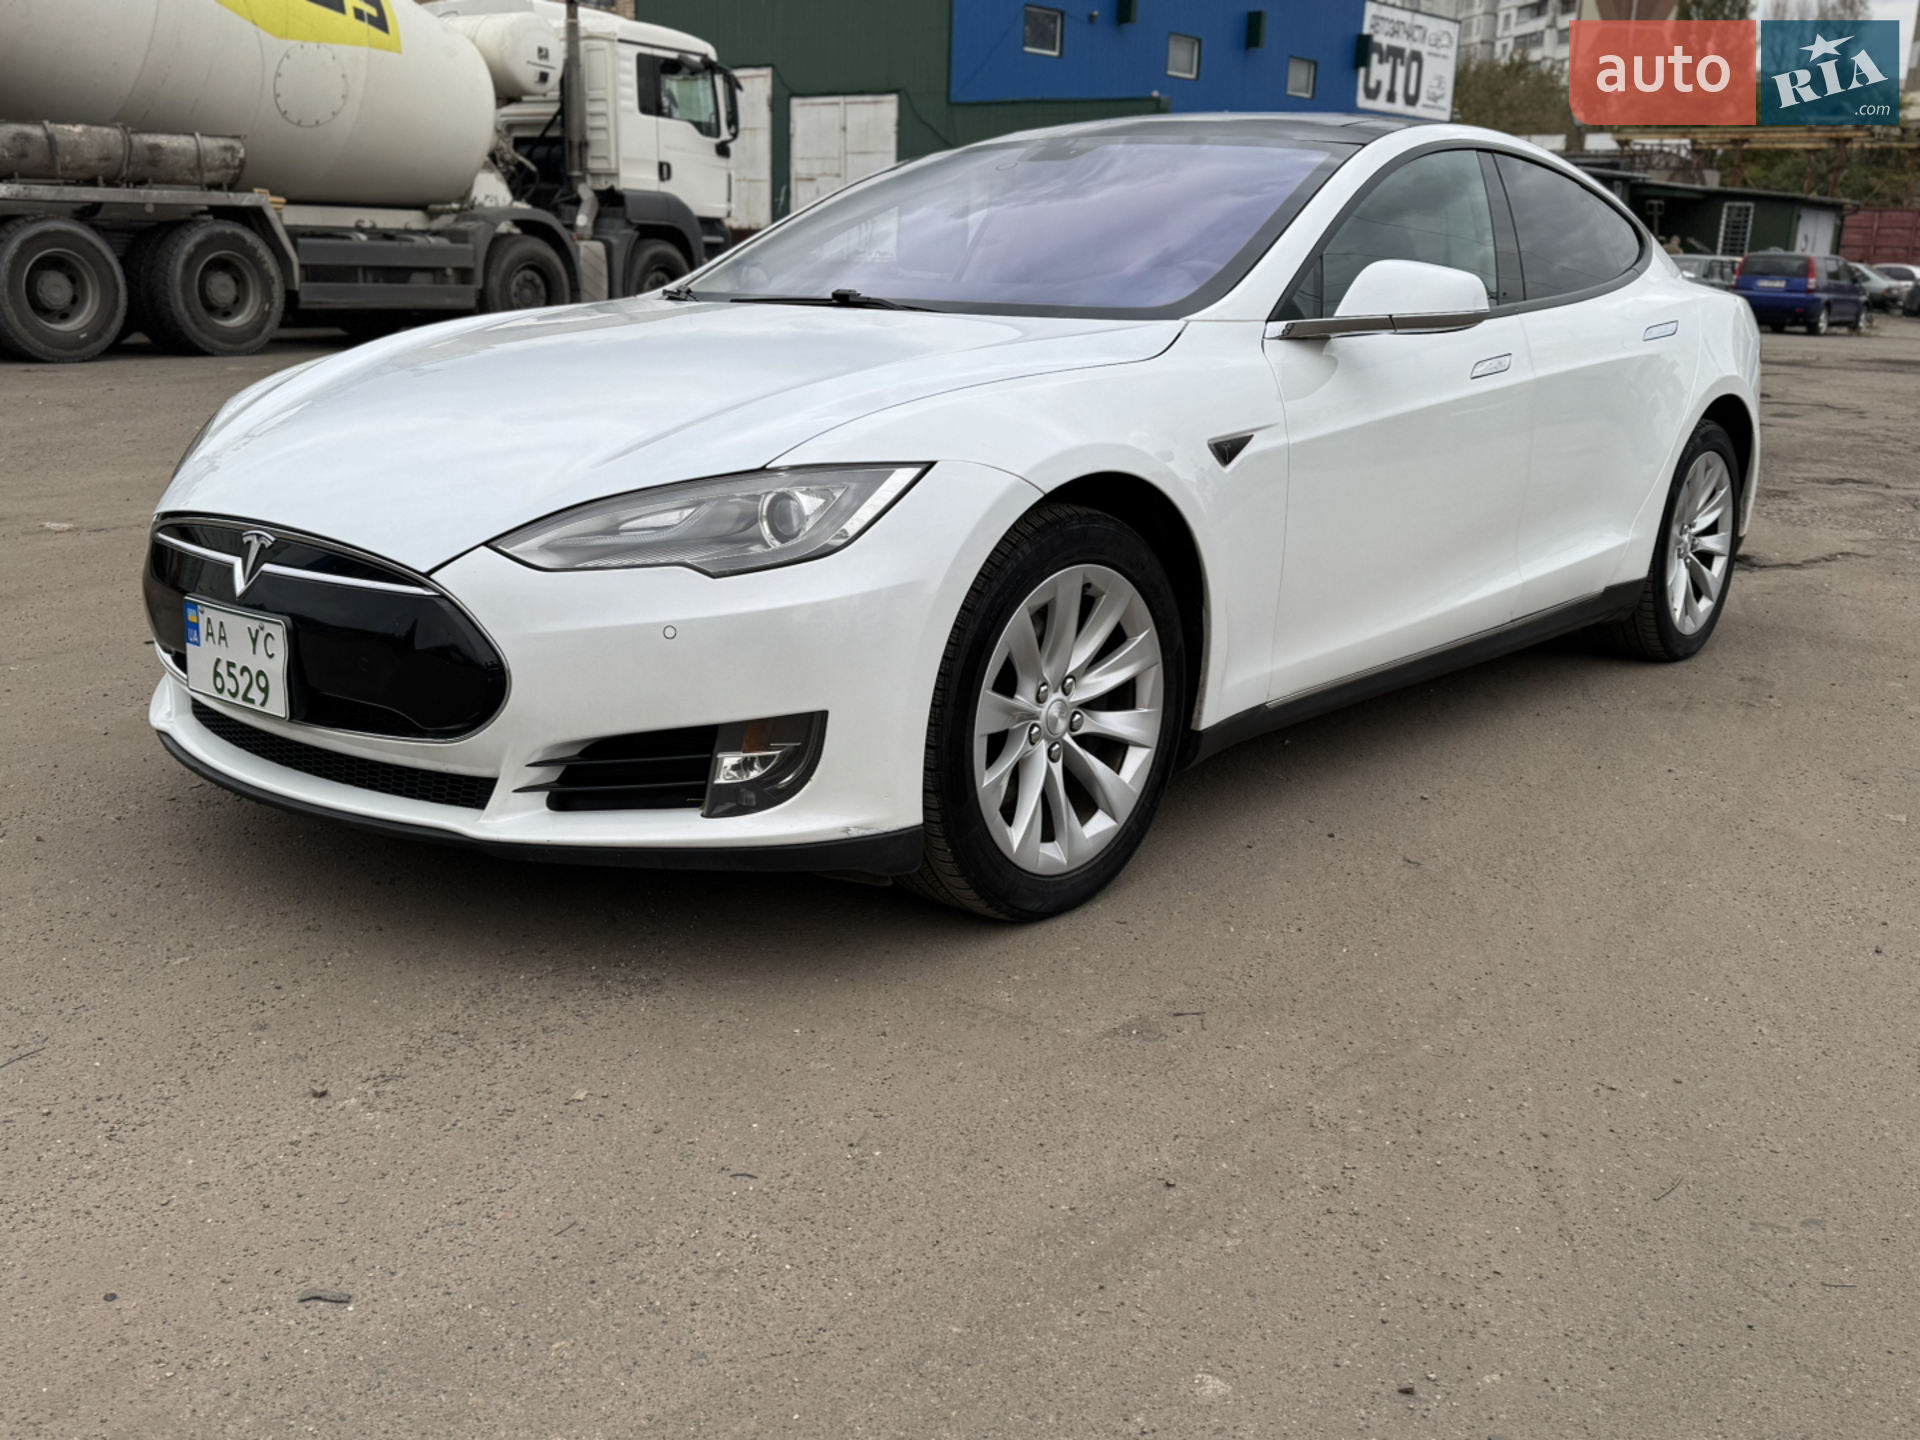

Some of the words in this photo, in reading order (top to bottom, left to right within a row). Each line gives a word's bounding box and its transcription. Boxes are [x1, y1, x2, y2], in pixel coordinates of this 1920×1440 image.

[1363, 41, 1423, 107] СТО
[187, 627, 200, 644] UA
[205, 616, 229, 649] AA
[213, 657, 270, 707] 6529
